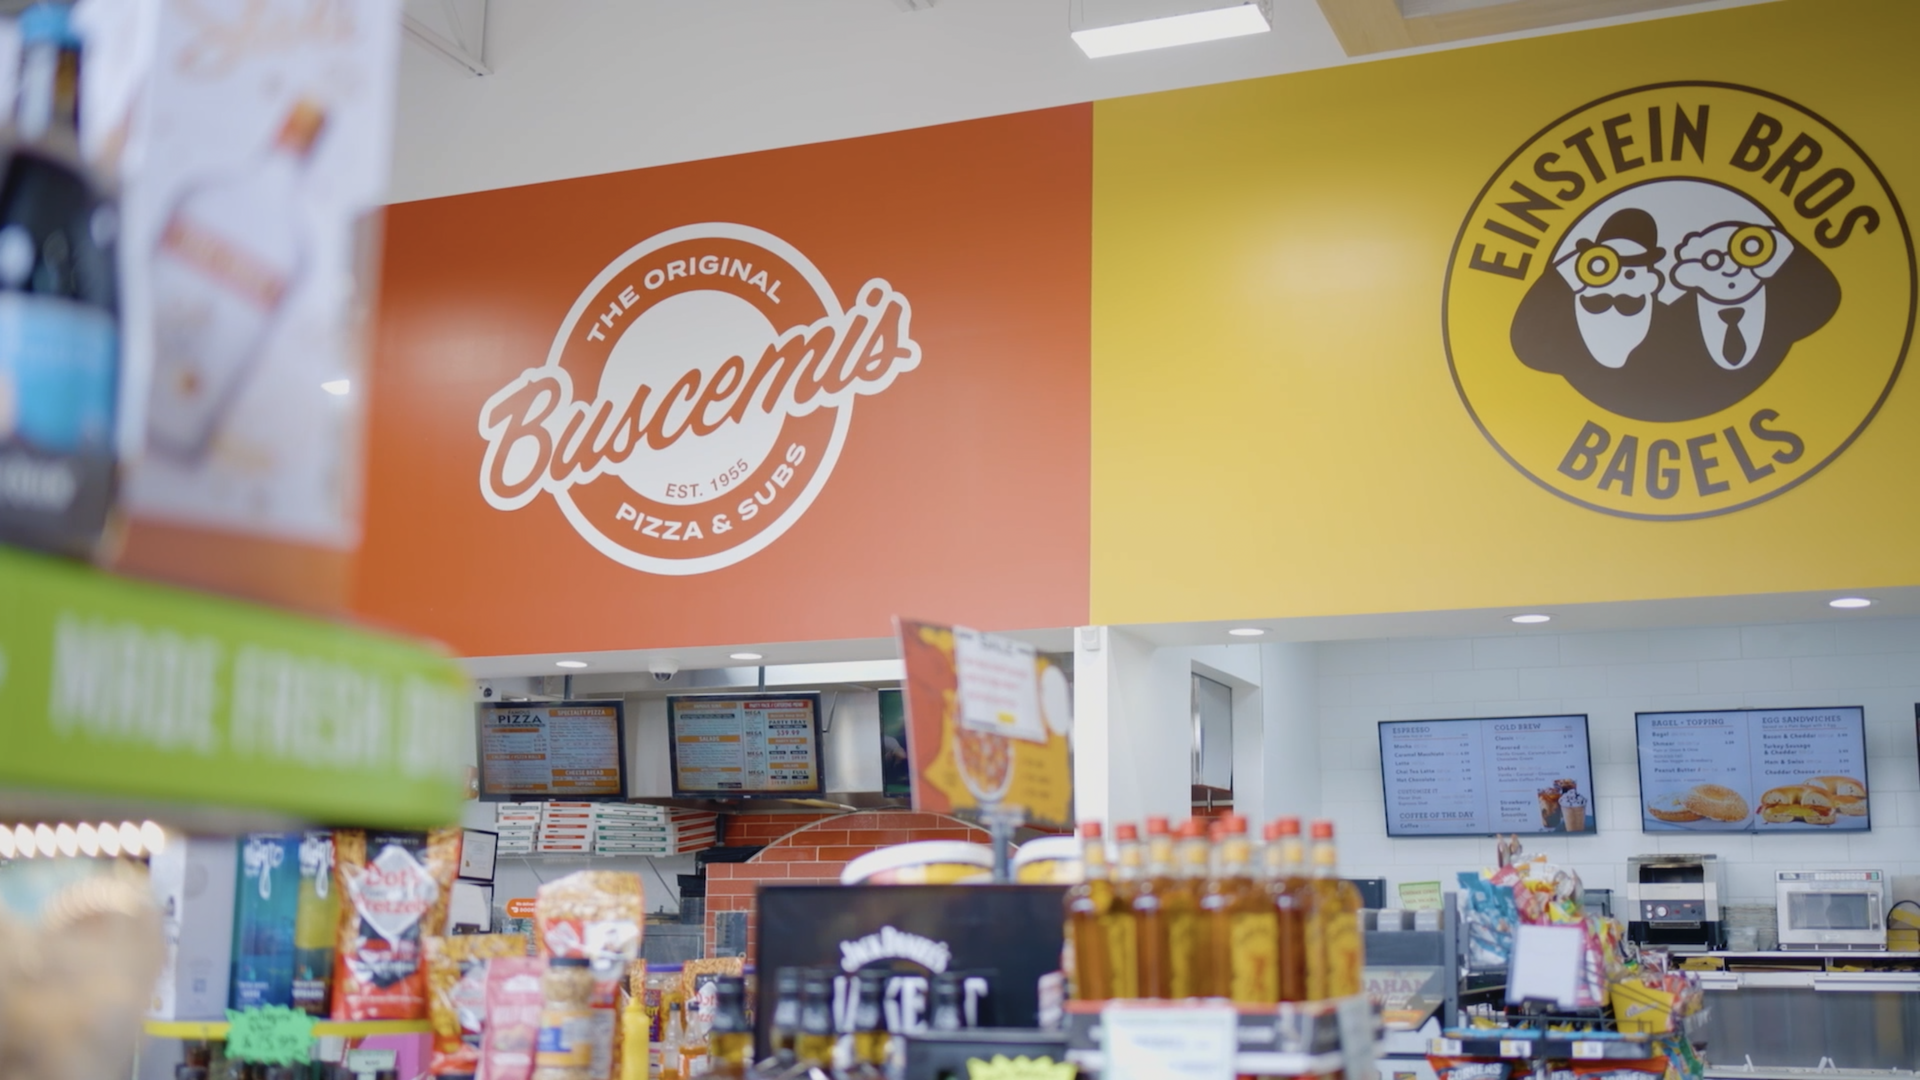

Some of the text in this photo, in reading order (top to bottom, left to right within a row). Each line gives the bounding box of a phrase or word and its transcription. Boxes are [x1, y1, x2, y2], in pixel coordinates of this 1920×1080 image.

[1468, 102, 1880, 281] EINSTEIN BROS
[587, 255, 782, 343] THE ORIGINAL
[1556, 408, 1805, 500] BAGELS
[665, 458, 749, 499] EST. 1955
[615, 443, 807, 541] PIZZA & SUBS
[498, 715, 542, 724] PIZZA
[1652, 719, 1679, 727] BAGEL
[1686, 718, 1725, 726] TOPPING
[1762, 715, 1842, 724] EGG SANDWICHES
[1393, 727, 1431, 735] ESPRESSO
[1518, 723, 1542, 731] BREW
[1652, 731, 1669, 739] Bagel
